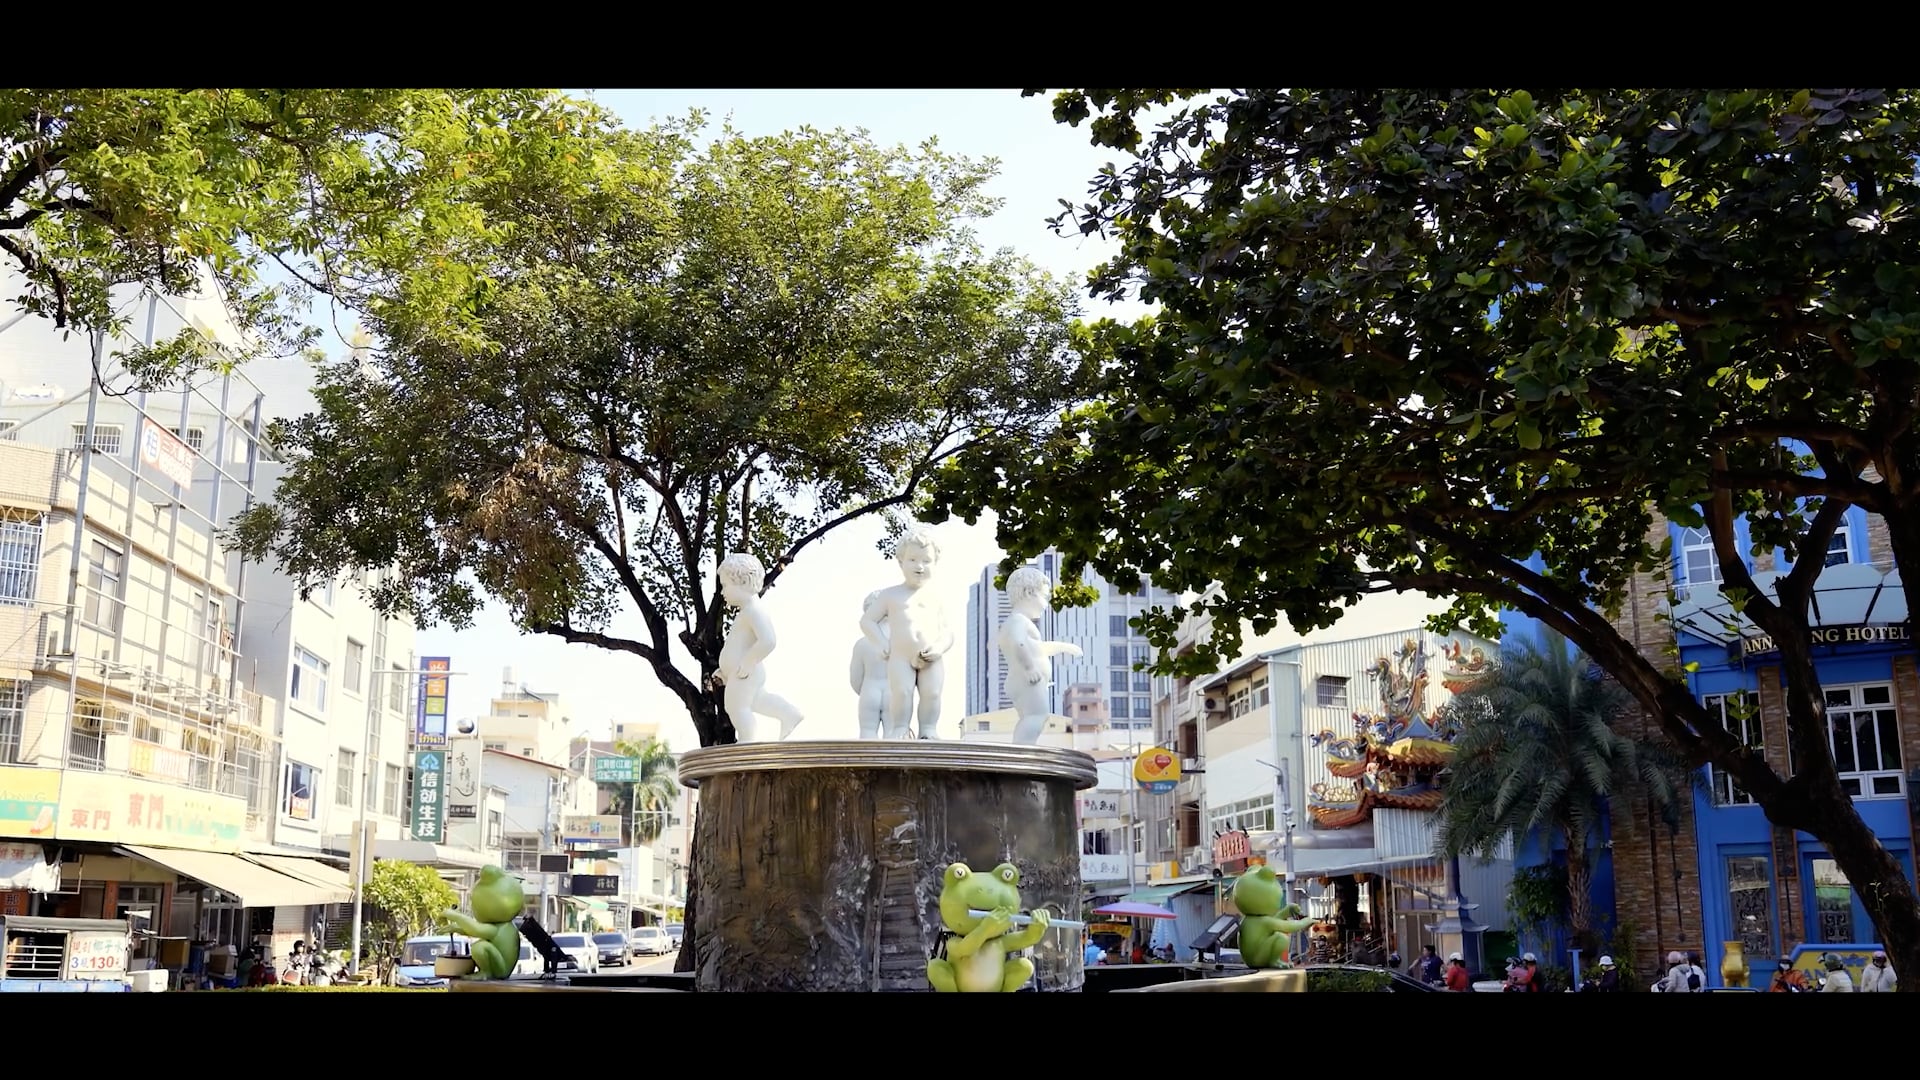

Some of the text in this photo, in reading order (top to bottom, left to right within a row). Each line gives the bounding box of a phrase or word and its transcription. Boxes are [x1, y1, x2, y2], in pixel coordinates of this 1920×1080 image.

[1845, 626, 1911, 641] HOTEL
[70, 808, 111, 831] 東門
[127, 792, 164, 831] 東門
